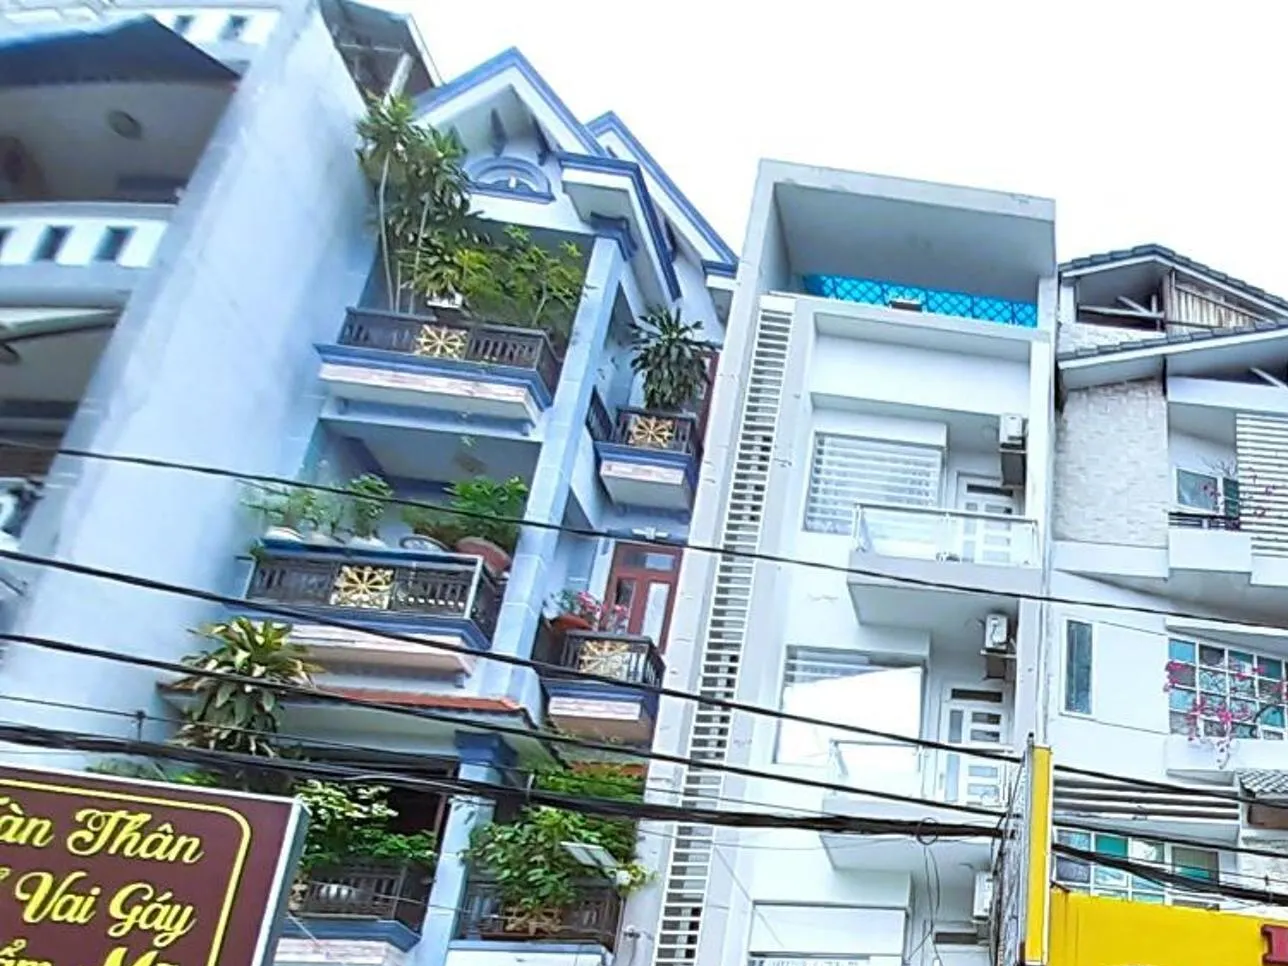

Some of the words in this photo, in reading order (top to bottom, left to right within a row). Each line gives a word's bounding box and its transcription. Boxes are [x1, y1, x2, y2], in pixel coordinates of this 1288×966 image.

[67, 808, 204, 863] Thân
[15, 872, 101, 924] Vai
[108, 883, 197, 947] Gáy
